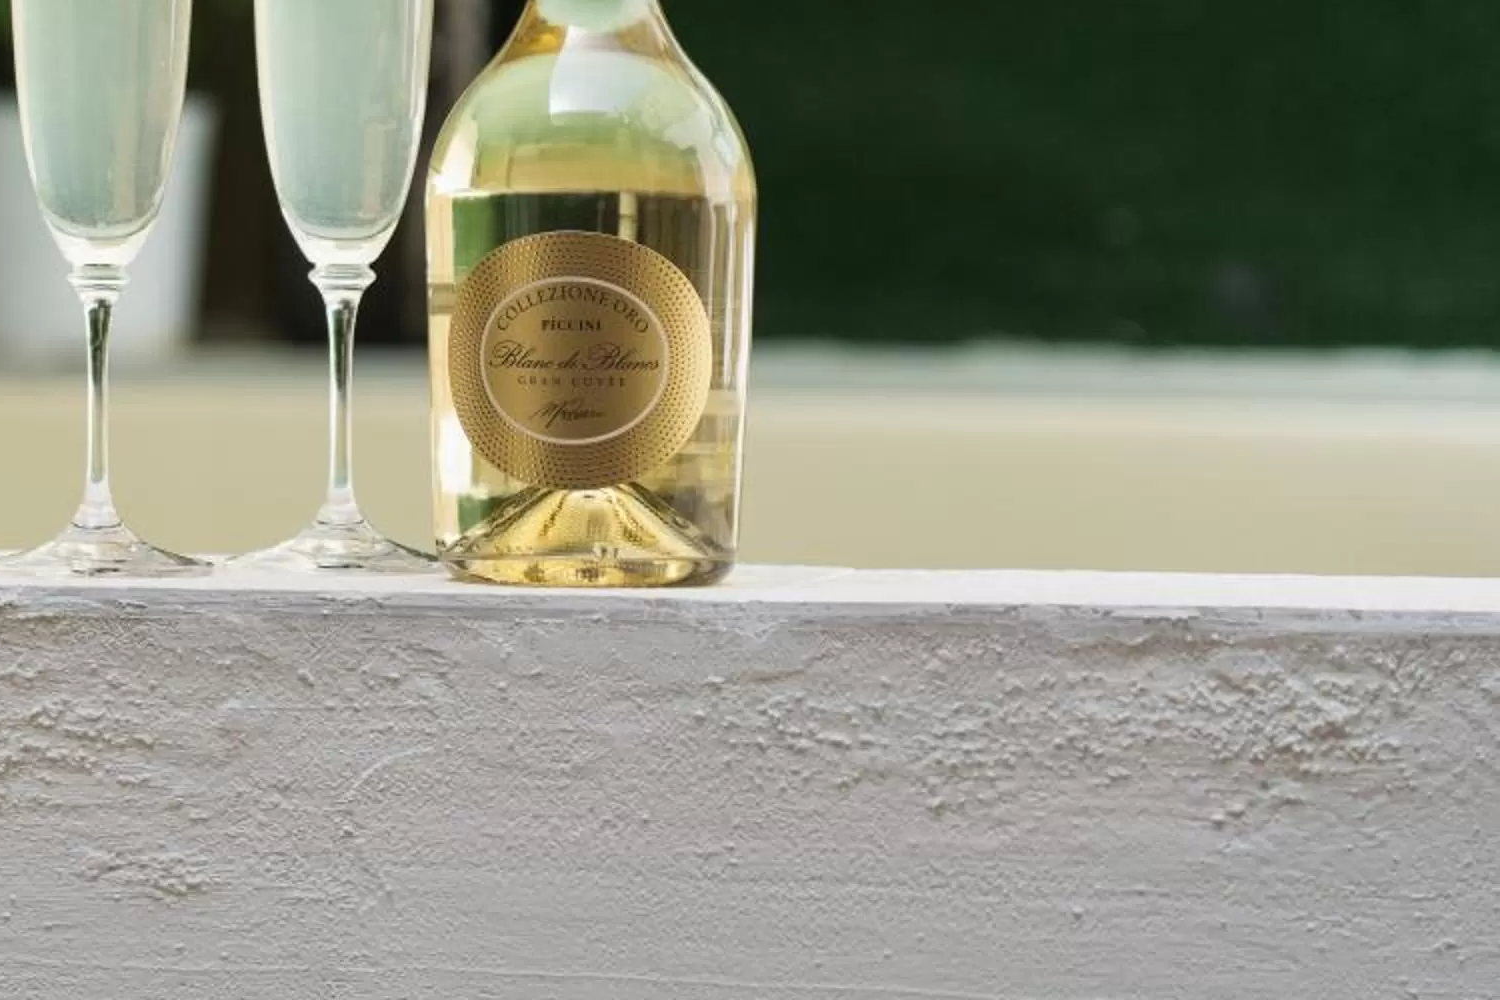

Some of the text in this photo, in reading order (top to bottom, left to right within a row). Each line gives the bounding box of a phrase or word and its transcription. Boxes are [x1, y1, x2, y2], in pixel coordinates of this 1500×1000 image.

[497, 285, 649, 333] COLLEZIONE ORO
[488, 339, 554, 370] Blanc
[554, 351, 580, 370] de
